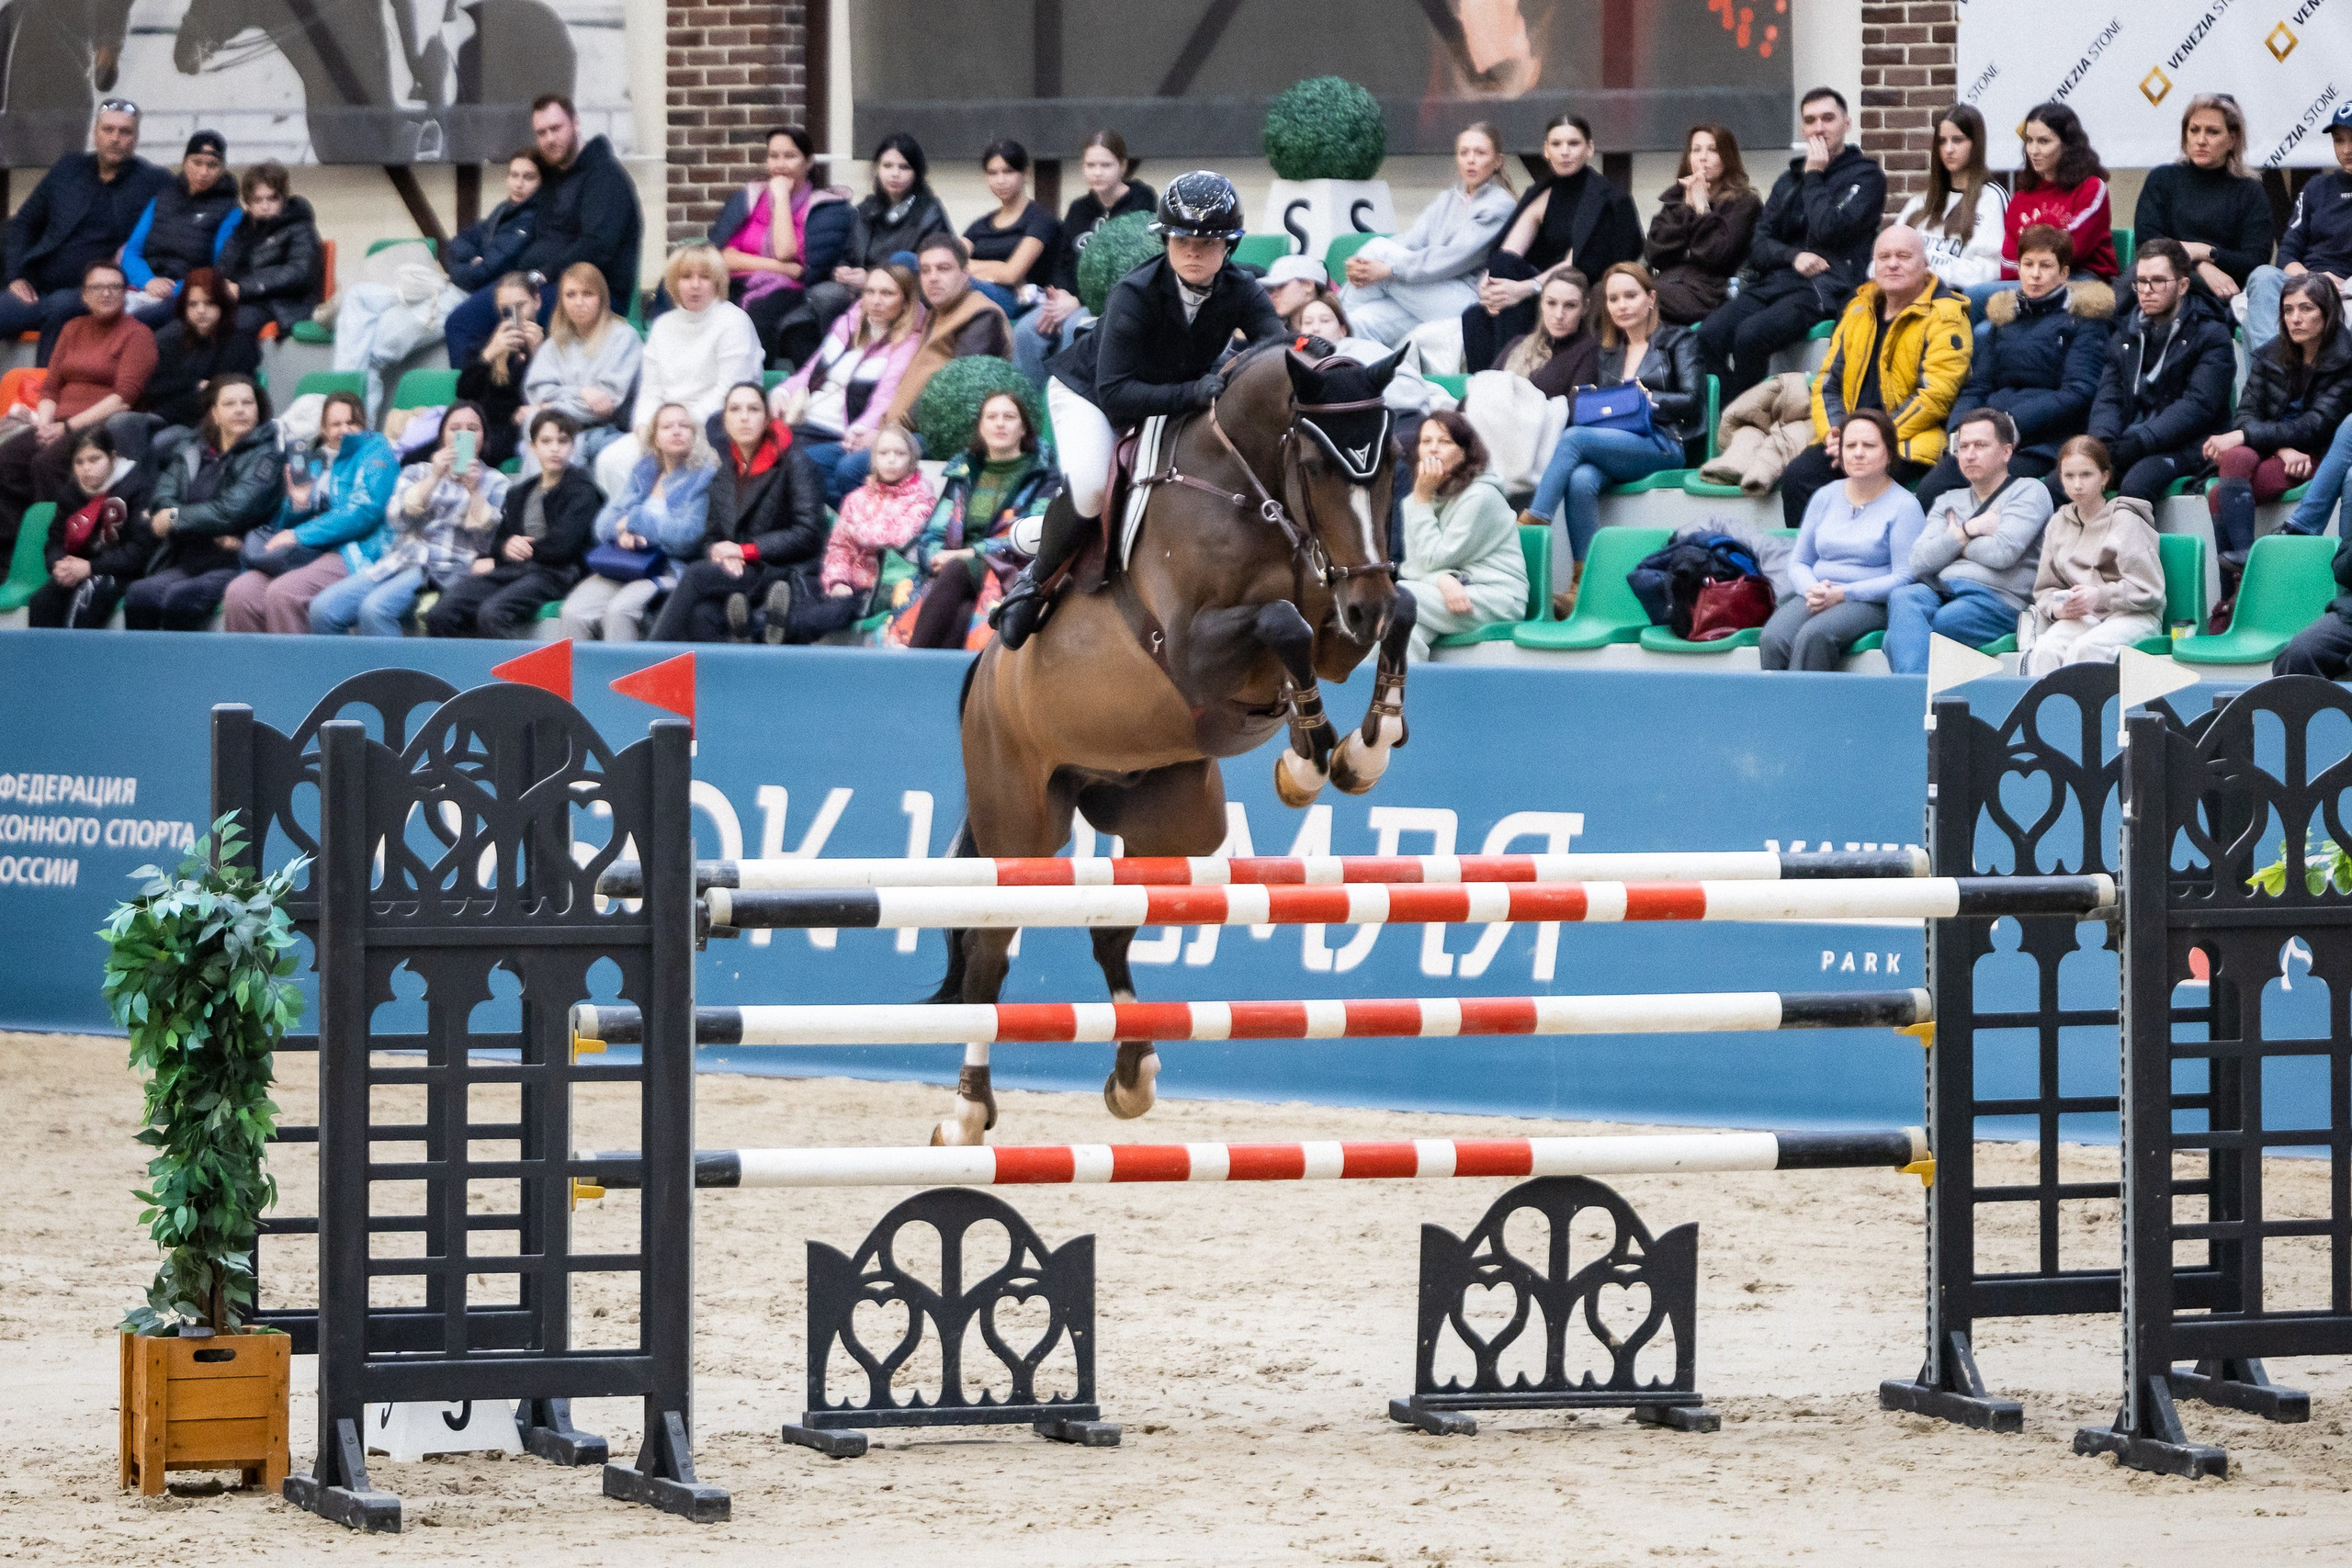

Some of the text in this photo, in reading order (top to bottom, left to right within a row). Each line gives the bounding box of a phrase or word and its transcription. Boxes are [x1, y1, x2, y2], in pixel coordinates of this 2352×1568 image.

[2293, 0, 2324, 26] VEN
[2167, 12, 2217, 70] VENEZIA
[2048, 17, 2123, 105] ENEZIA STONE
[1967, 61, 2001, 104] STONE
[2263, 82, 2340, 167] NEZIA STONE
[0, 773, 137, 808] ФЕДЕРАЦИЯ
[104, 818, 196, 850] СПОРТА
[1820, 949, 1902, 974] PARK
